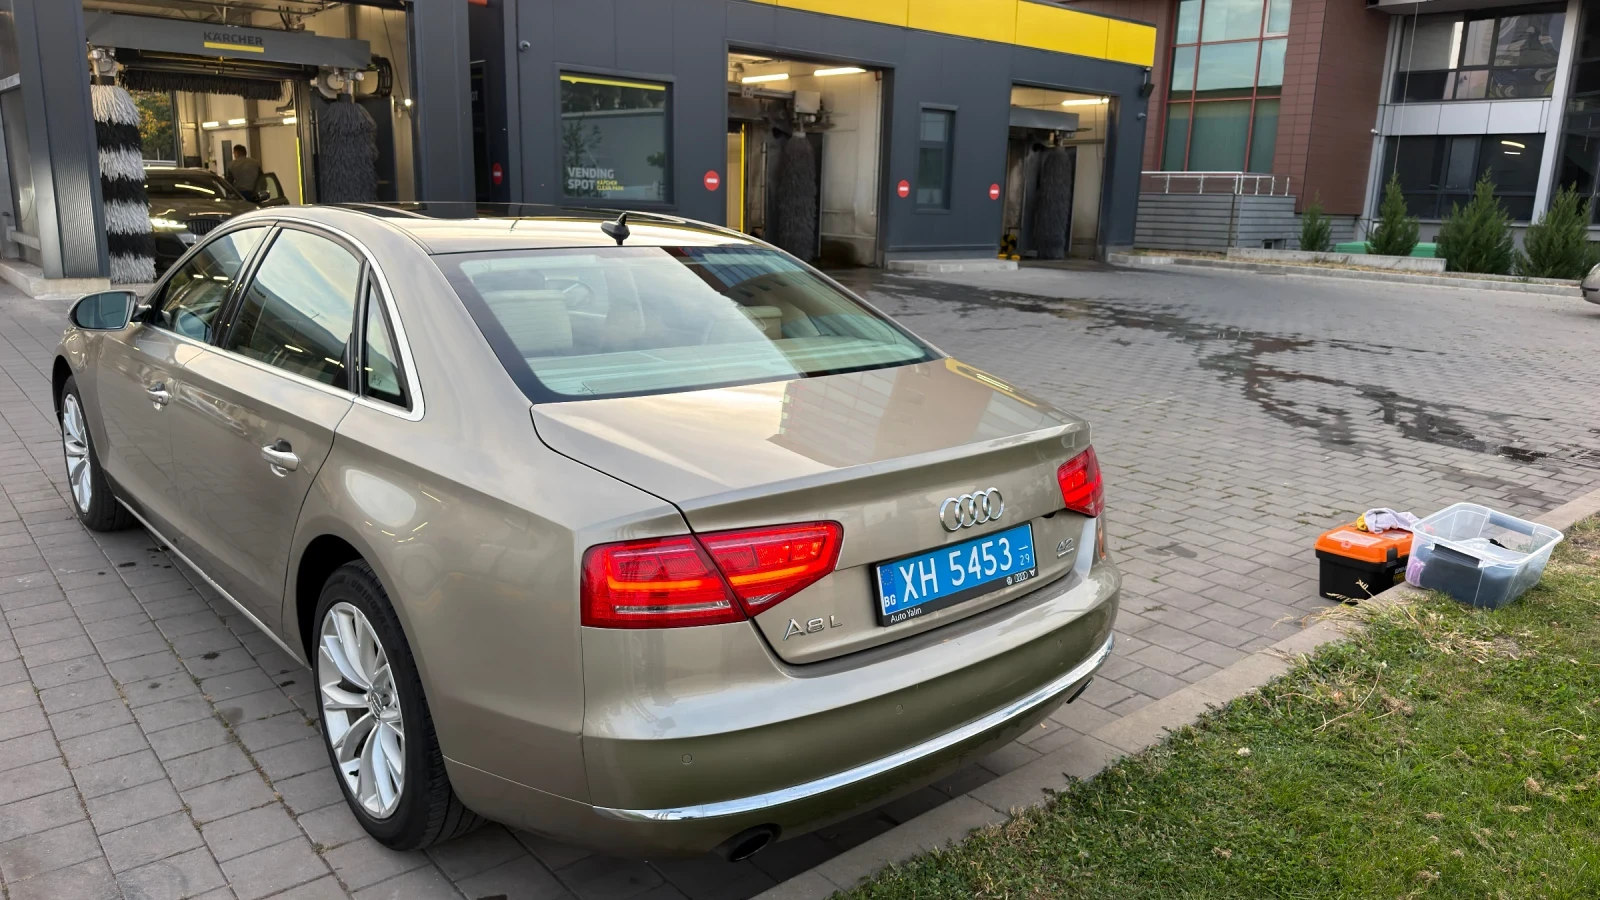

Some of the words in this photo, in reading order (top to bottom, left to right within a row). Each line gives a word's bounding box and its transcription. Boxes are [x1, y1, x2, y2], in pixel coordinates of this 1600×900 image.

[567, 167, 614, 179] VENDING
[567, 179, 595, 190] SPOT
[1019, 553, 1030, 566] 29
[898, 557, 939, 603] XH
[948, 537, 1013, 587] 5453
[884, 594, 896, 608] BG
[891, 612, 906, 624] Auto
[783, 617, 825, 641] A8
[828, 614, 843, 628] L
